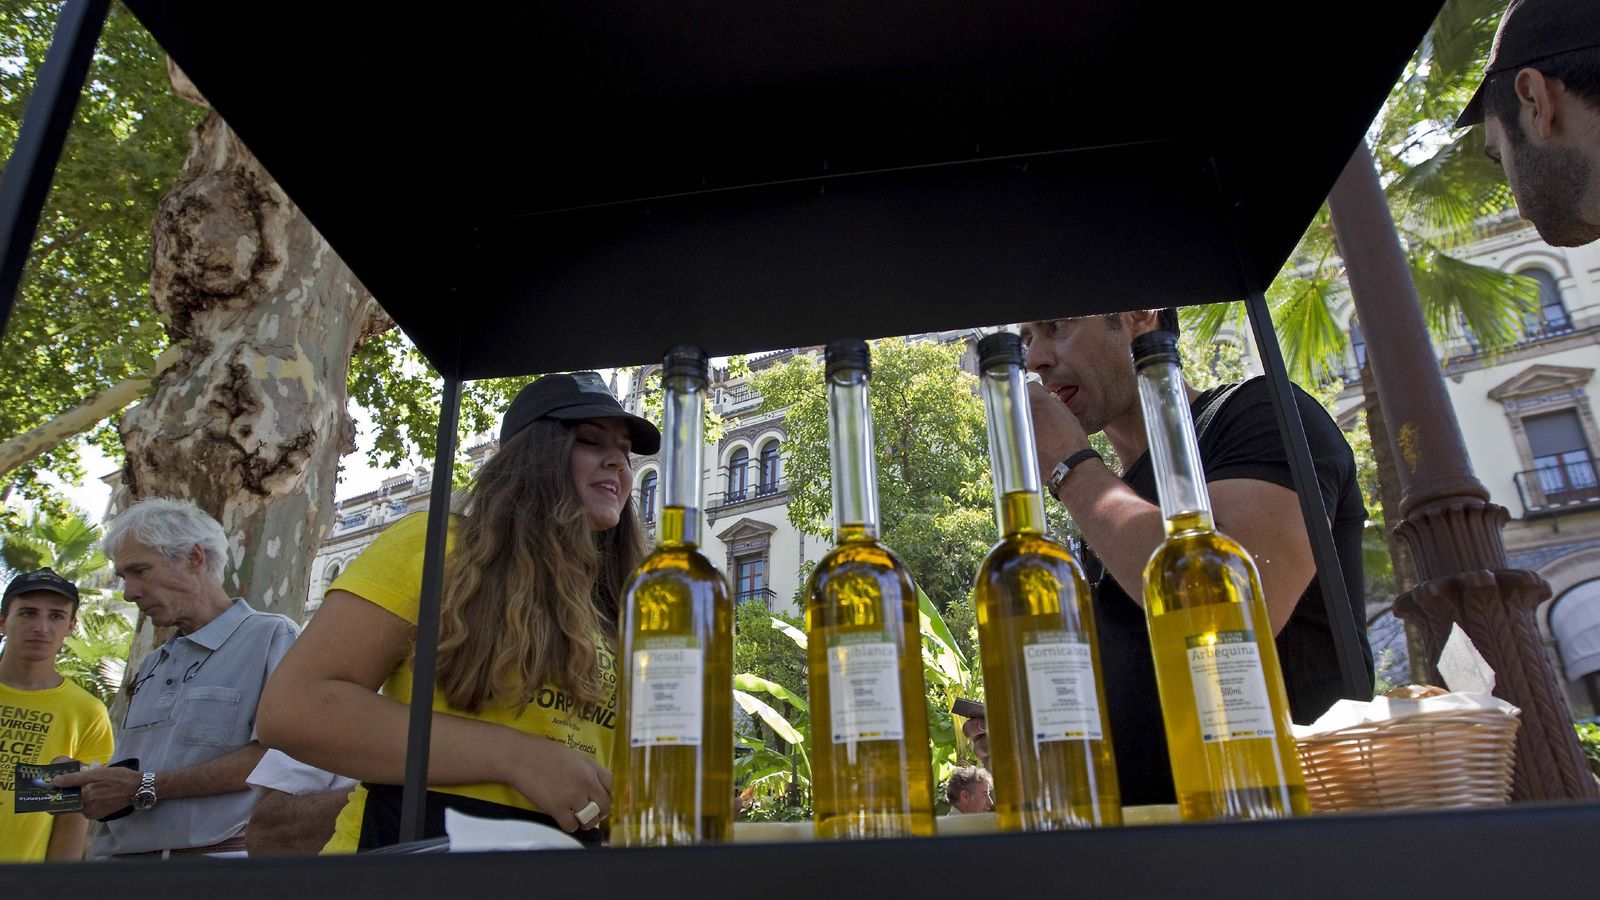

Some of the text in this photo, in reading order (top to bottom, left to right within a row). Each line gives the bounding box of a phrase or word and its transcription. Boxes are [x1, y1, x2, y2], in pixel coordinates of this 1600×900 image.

[1191, 645, 1256, 661] Arbequina
[0, 718, 50, 733] VIRGEN
[0, 728, 47, 745] ANTE
